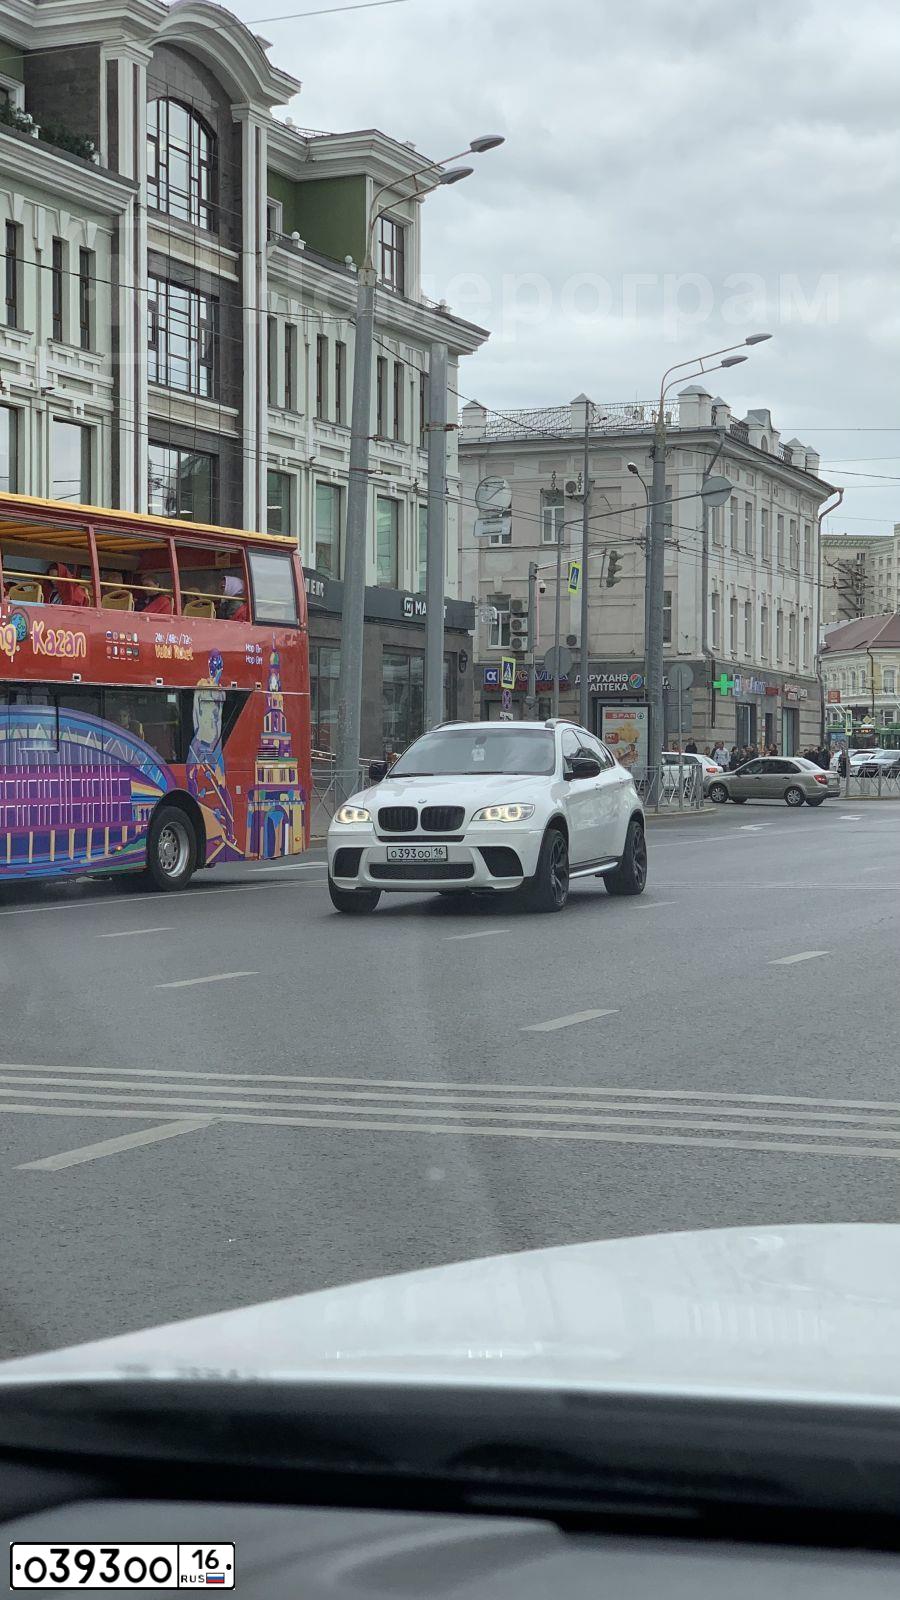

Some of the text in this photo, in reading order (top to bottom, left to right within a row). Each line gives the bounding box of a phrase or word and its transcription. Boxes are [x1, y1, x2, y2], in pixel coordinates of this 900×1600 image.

[33, 620, 86, 657] Kazan
[575, 674, 629, 684] ДРУХАНӘ
[589, 683, 629, 692] АПТЕКА
